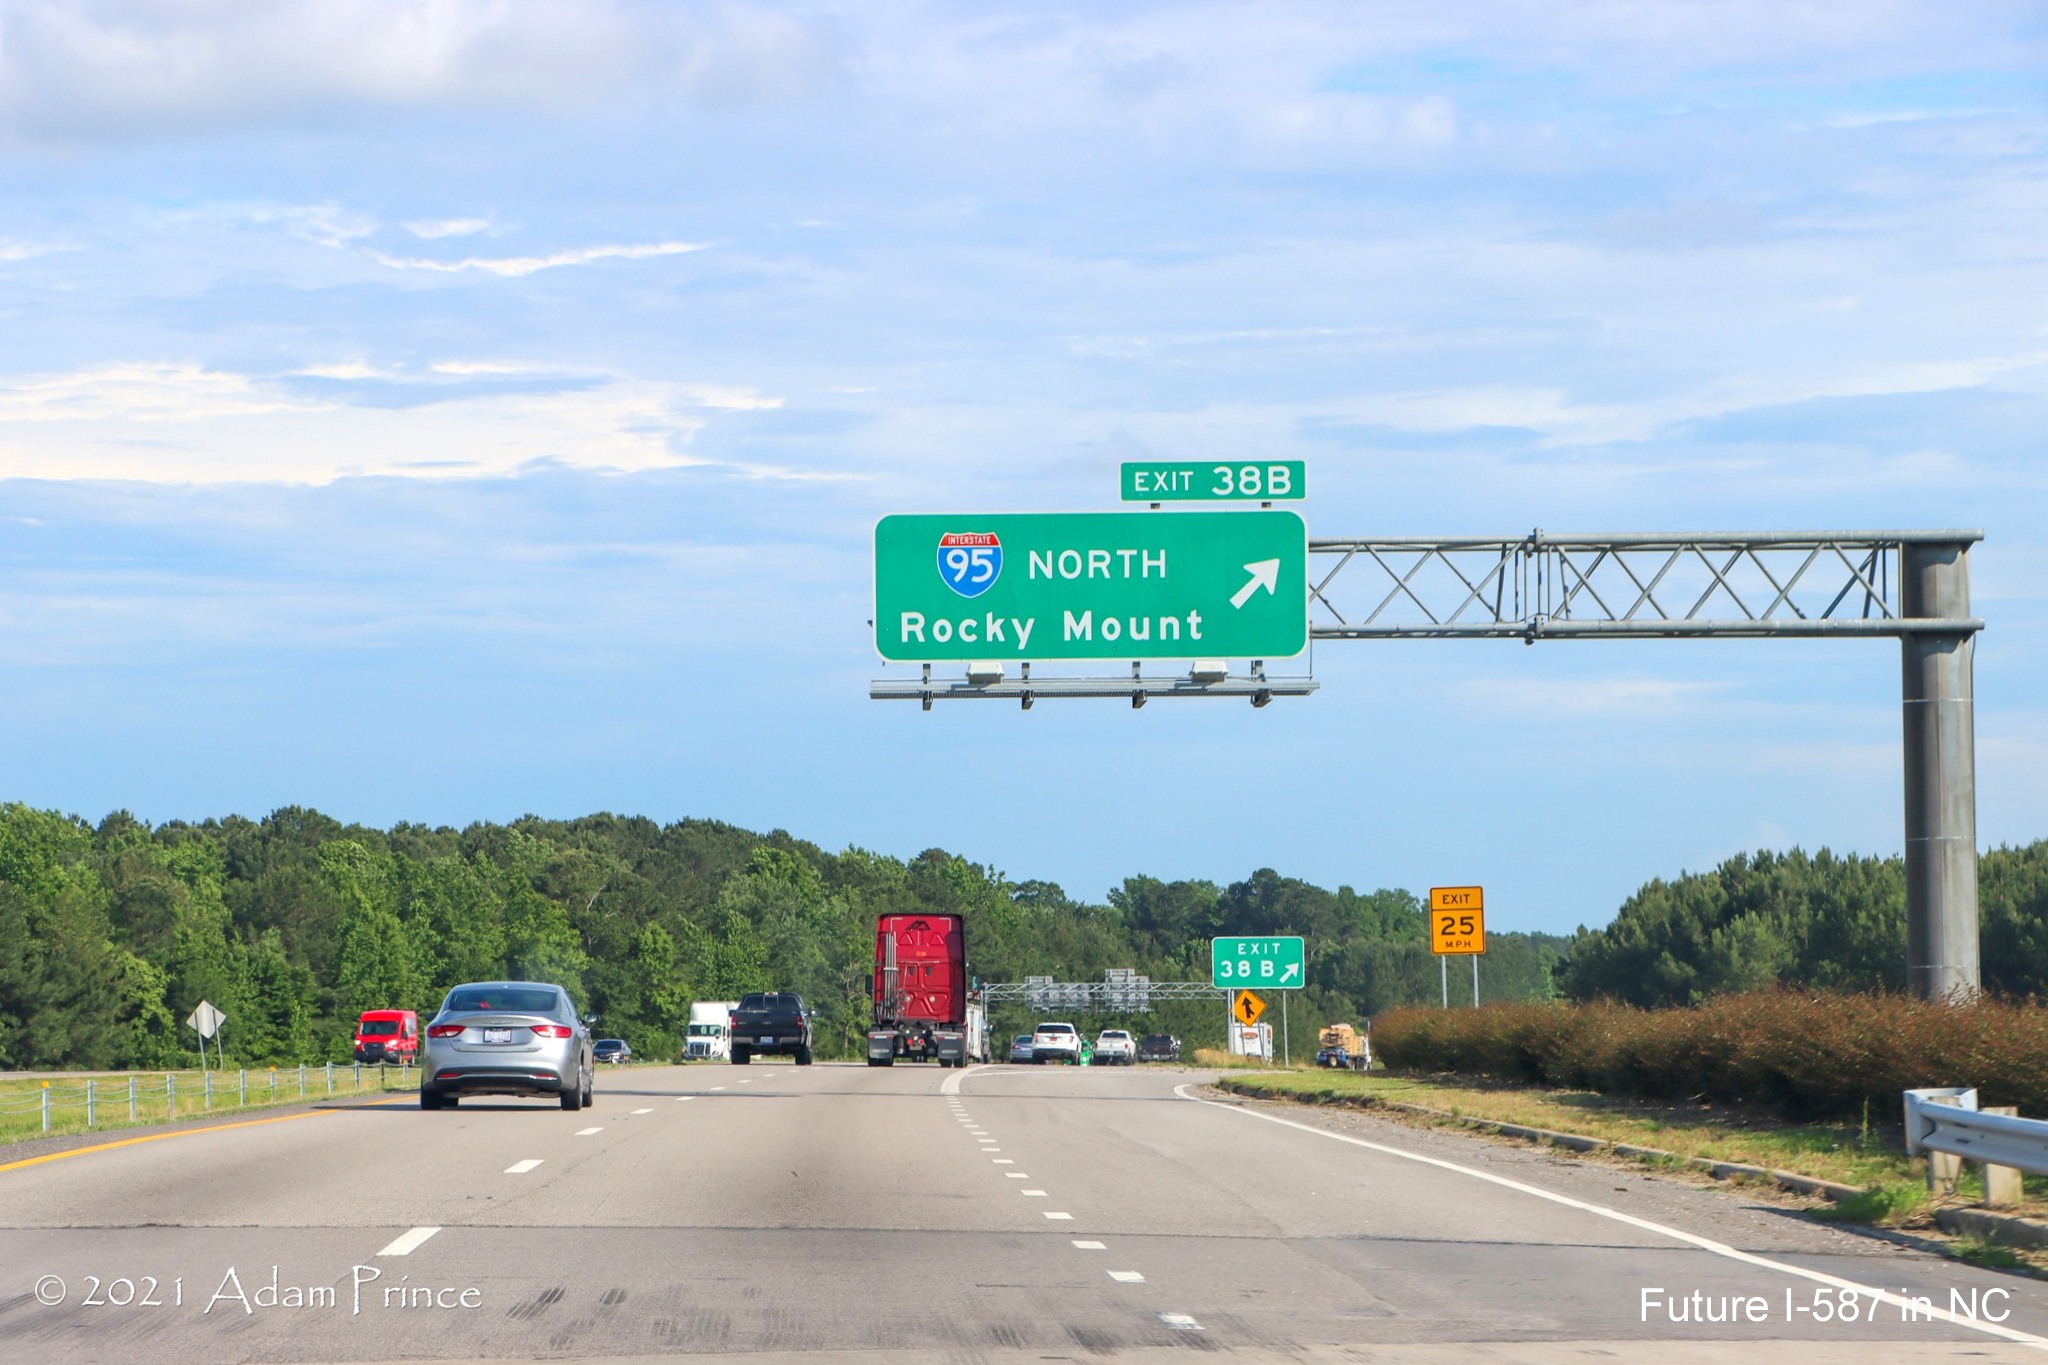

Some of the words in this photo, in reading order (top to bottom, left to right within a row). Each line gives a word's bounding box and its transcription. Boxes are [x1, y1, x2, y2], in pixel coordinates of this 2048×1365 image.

[1134, 471, 1194, 492] EXIT
[1211, 465, 1292, 496] 38B
[947, 536, 992, 545] INTERSTATE
[946, 548, 994, 583] 95
[1029, 549, 1166, 580] NORTH
[900, 611, 1036, 650] Rocky
[1063, 609, 1203, 642] Mount
[1442, 893, 1471, 905] EXIT
[1441, 916, 1474, 936] 25
[1237, 942, 1281, 956] EXIT
